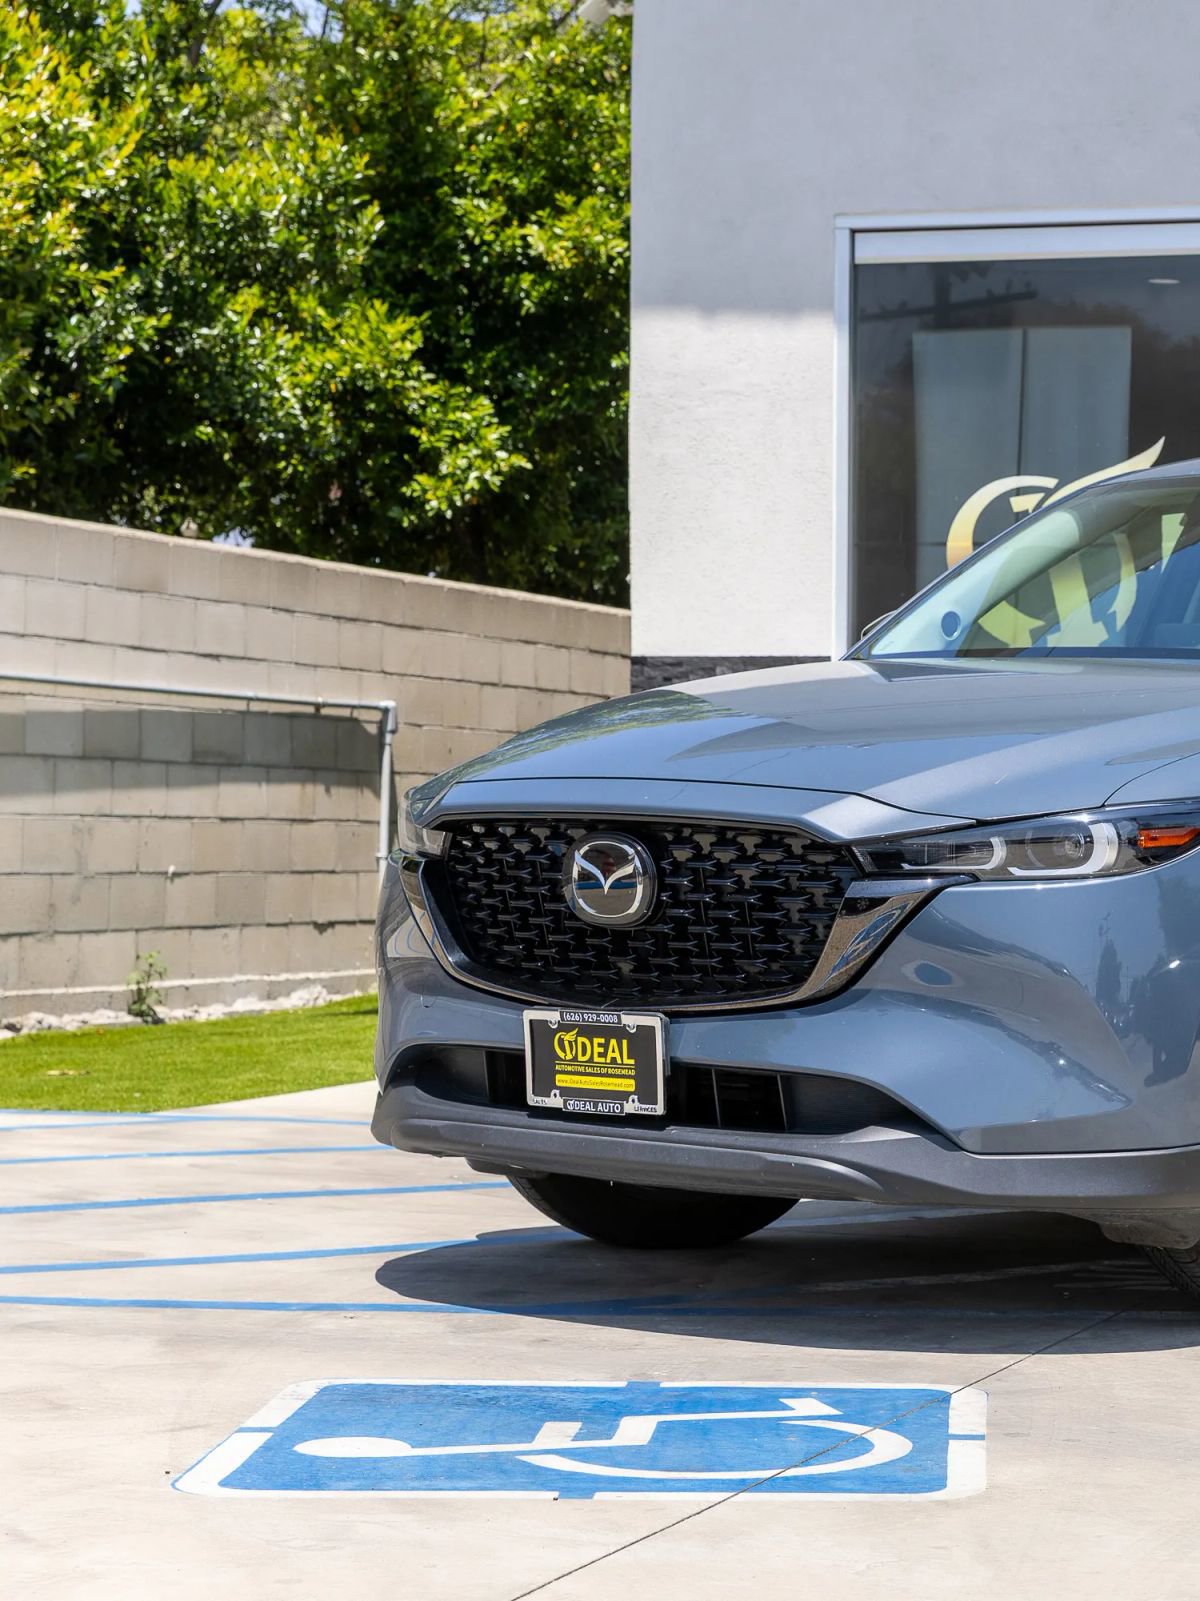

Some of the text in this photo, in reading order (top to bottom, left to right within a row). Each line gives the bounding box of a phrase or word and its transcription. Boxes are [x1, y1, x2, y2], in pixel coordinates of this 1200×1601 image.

[563, 1011, 618, 1023] (626) 929-0008
[555, 1064, 585, 1073] AUTOMOTIVE
[585, 1066, 601, 1074] SALES
[608, 1068, 636, 1076] ROSEMEAD
[597, 1102, 621, 1113] AUTO
